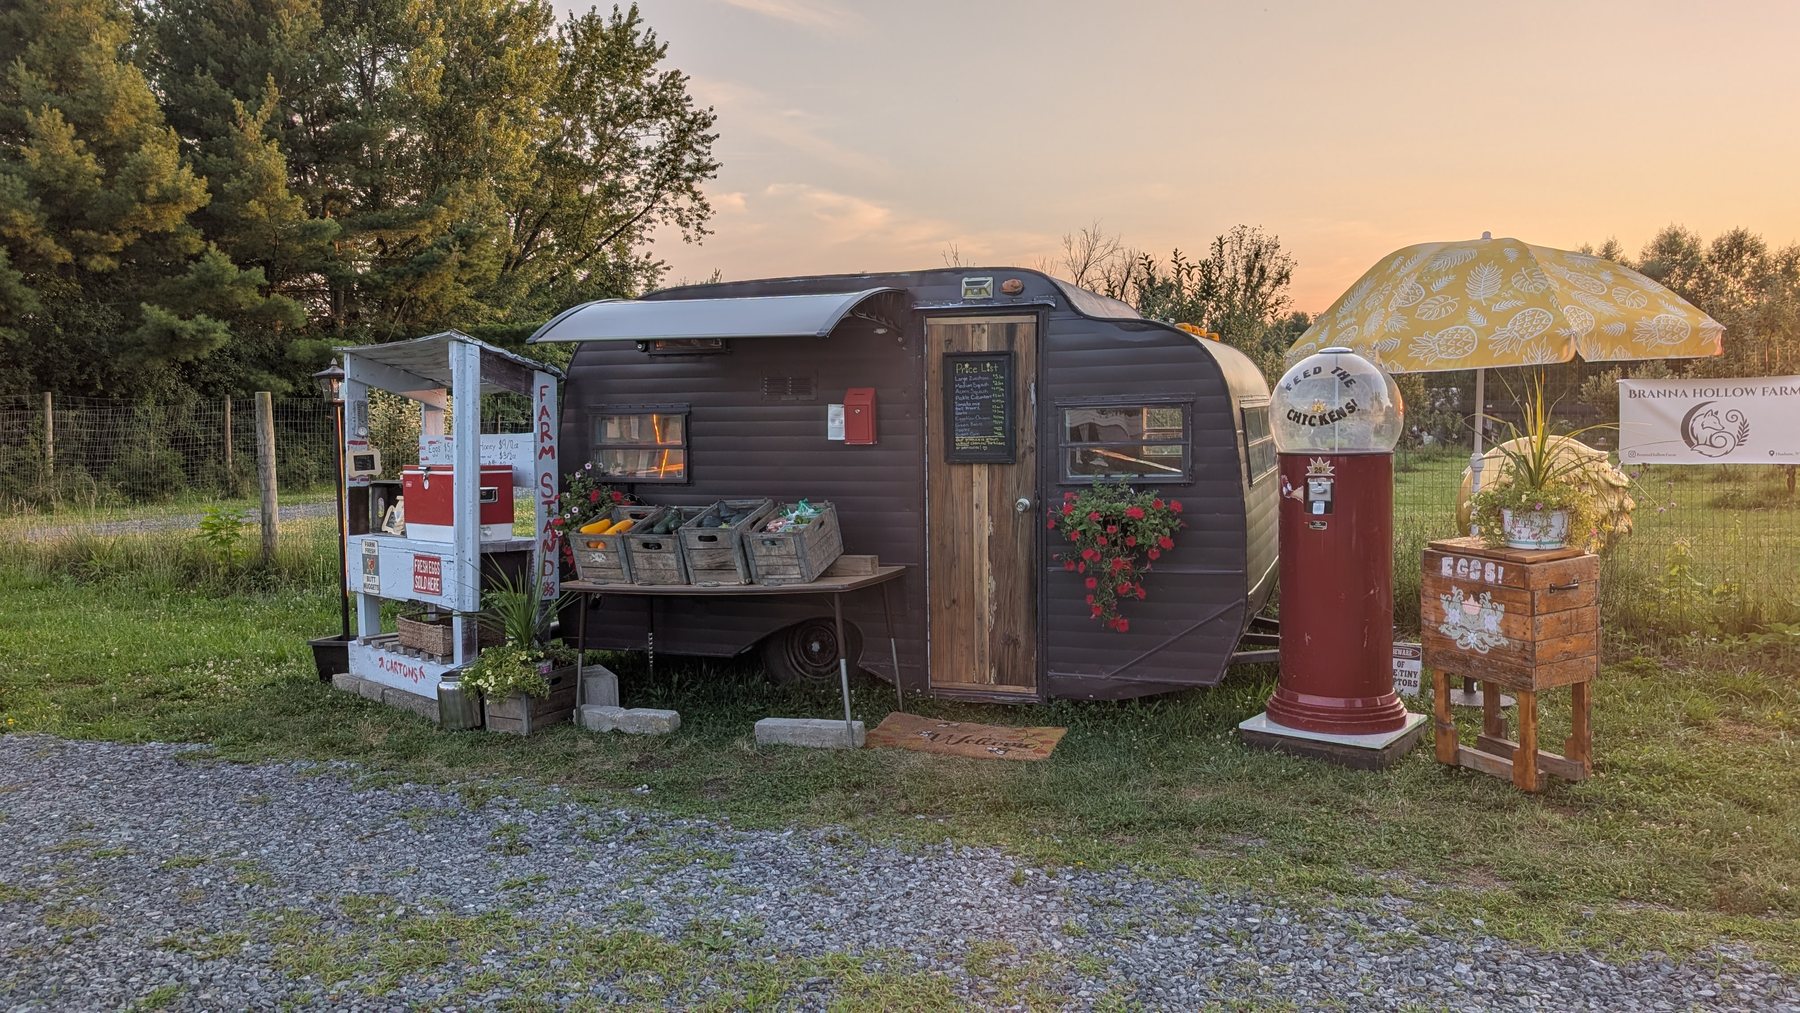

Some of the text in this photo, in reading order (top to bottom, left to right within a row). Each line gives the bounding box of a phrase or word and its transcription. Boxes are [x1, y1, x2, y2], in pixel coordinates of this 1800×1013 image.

[956, 361, 999, 374] Price List
[1285, 366, 1356, 391] FEED THE
[1629, 385, 1800, 399] BRANNA HOLLOW FARM
[1286, 398, 1360, 427] CHICKENS!
[538, 385, 557, 577] FARM STAND
[414, 558, 441, 576] FRESH EGGS
[1441, 556, 1504, 584] EGGS!
[414, 575, 440, 592] SOLD HERE
[385, 659, 419, 684] CARTONS
[1396, 660, 1406, 669] OF
[1400, 669, 1419, 679] TINY
